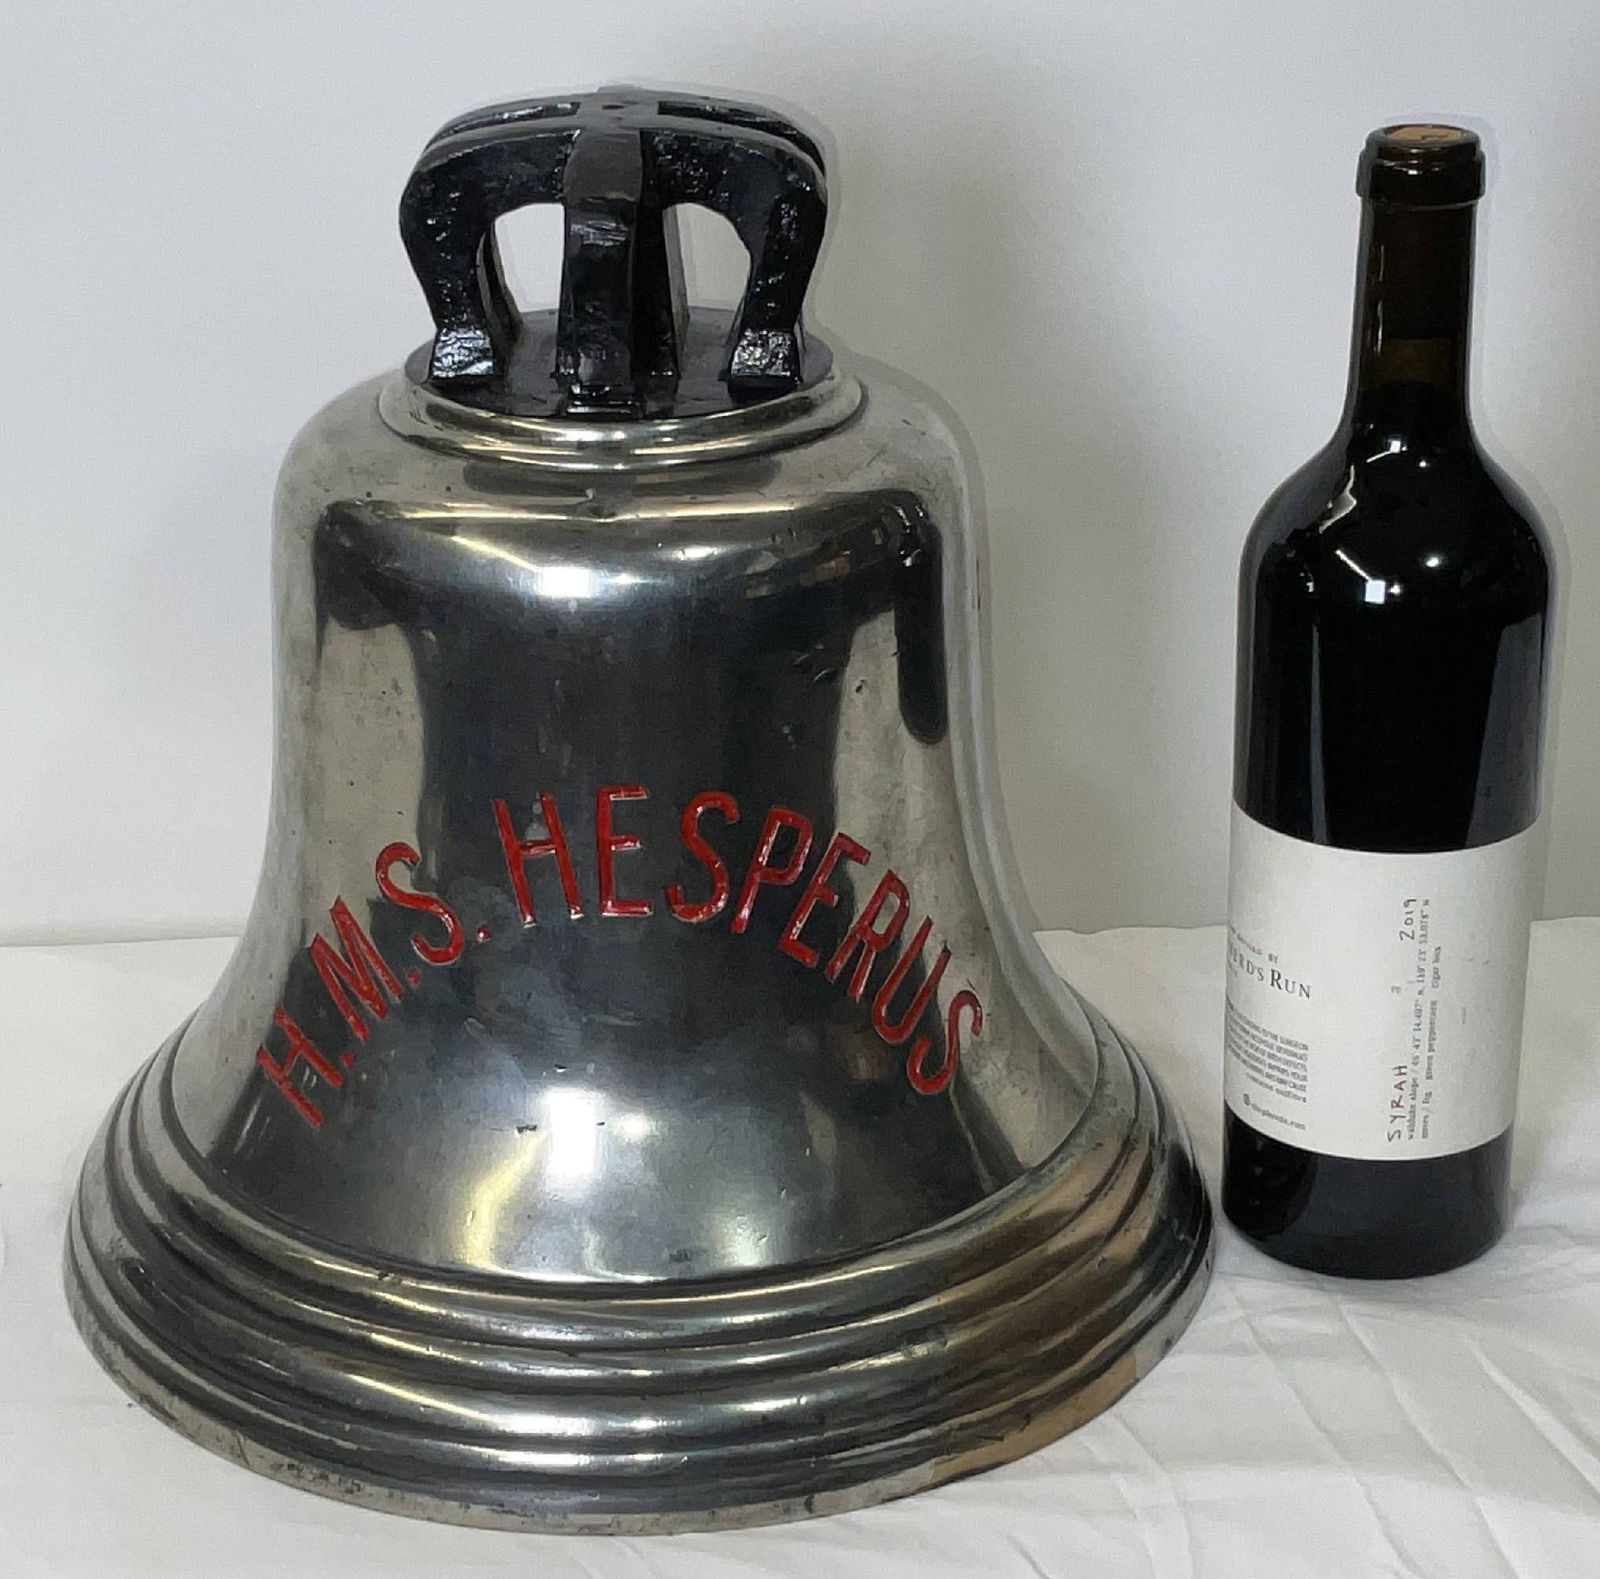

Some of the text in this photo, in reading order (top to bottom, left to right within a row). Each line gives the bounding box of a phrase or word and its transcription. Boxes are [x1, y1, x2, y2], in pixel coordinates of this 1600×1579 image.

[258, 783, 983, 1127] H.M.S. HESPERUS
[1269, 968, 1311, 999] RUN
[1386, 898, 1418, 1142] SYRAH 2019
